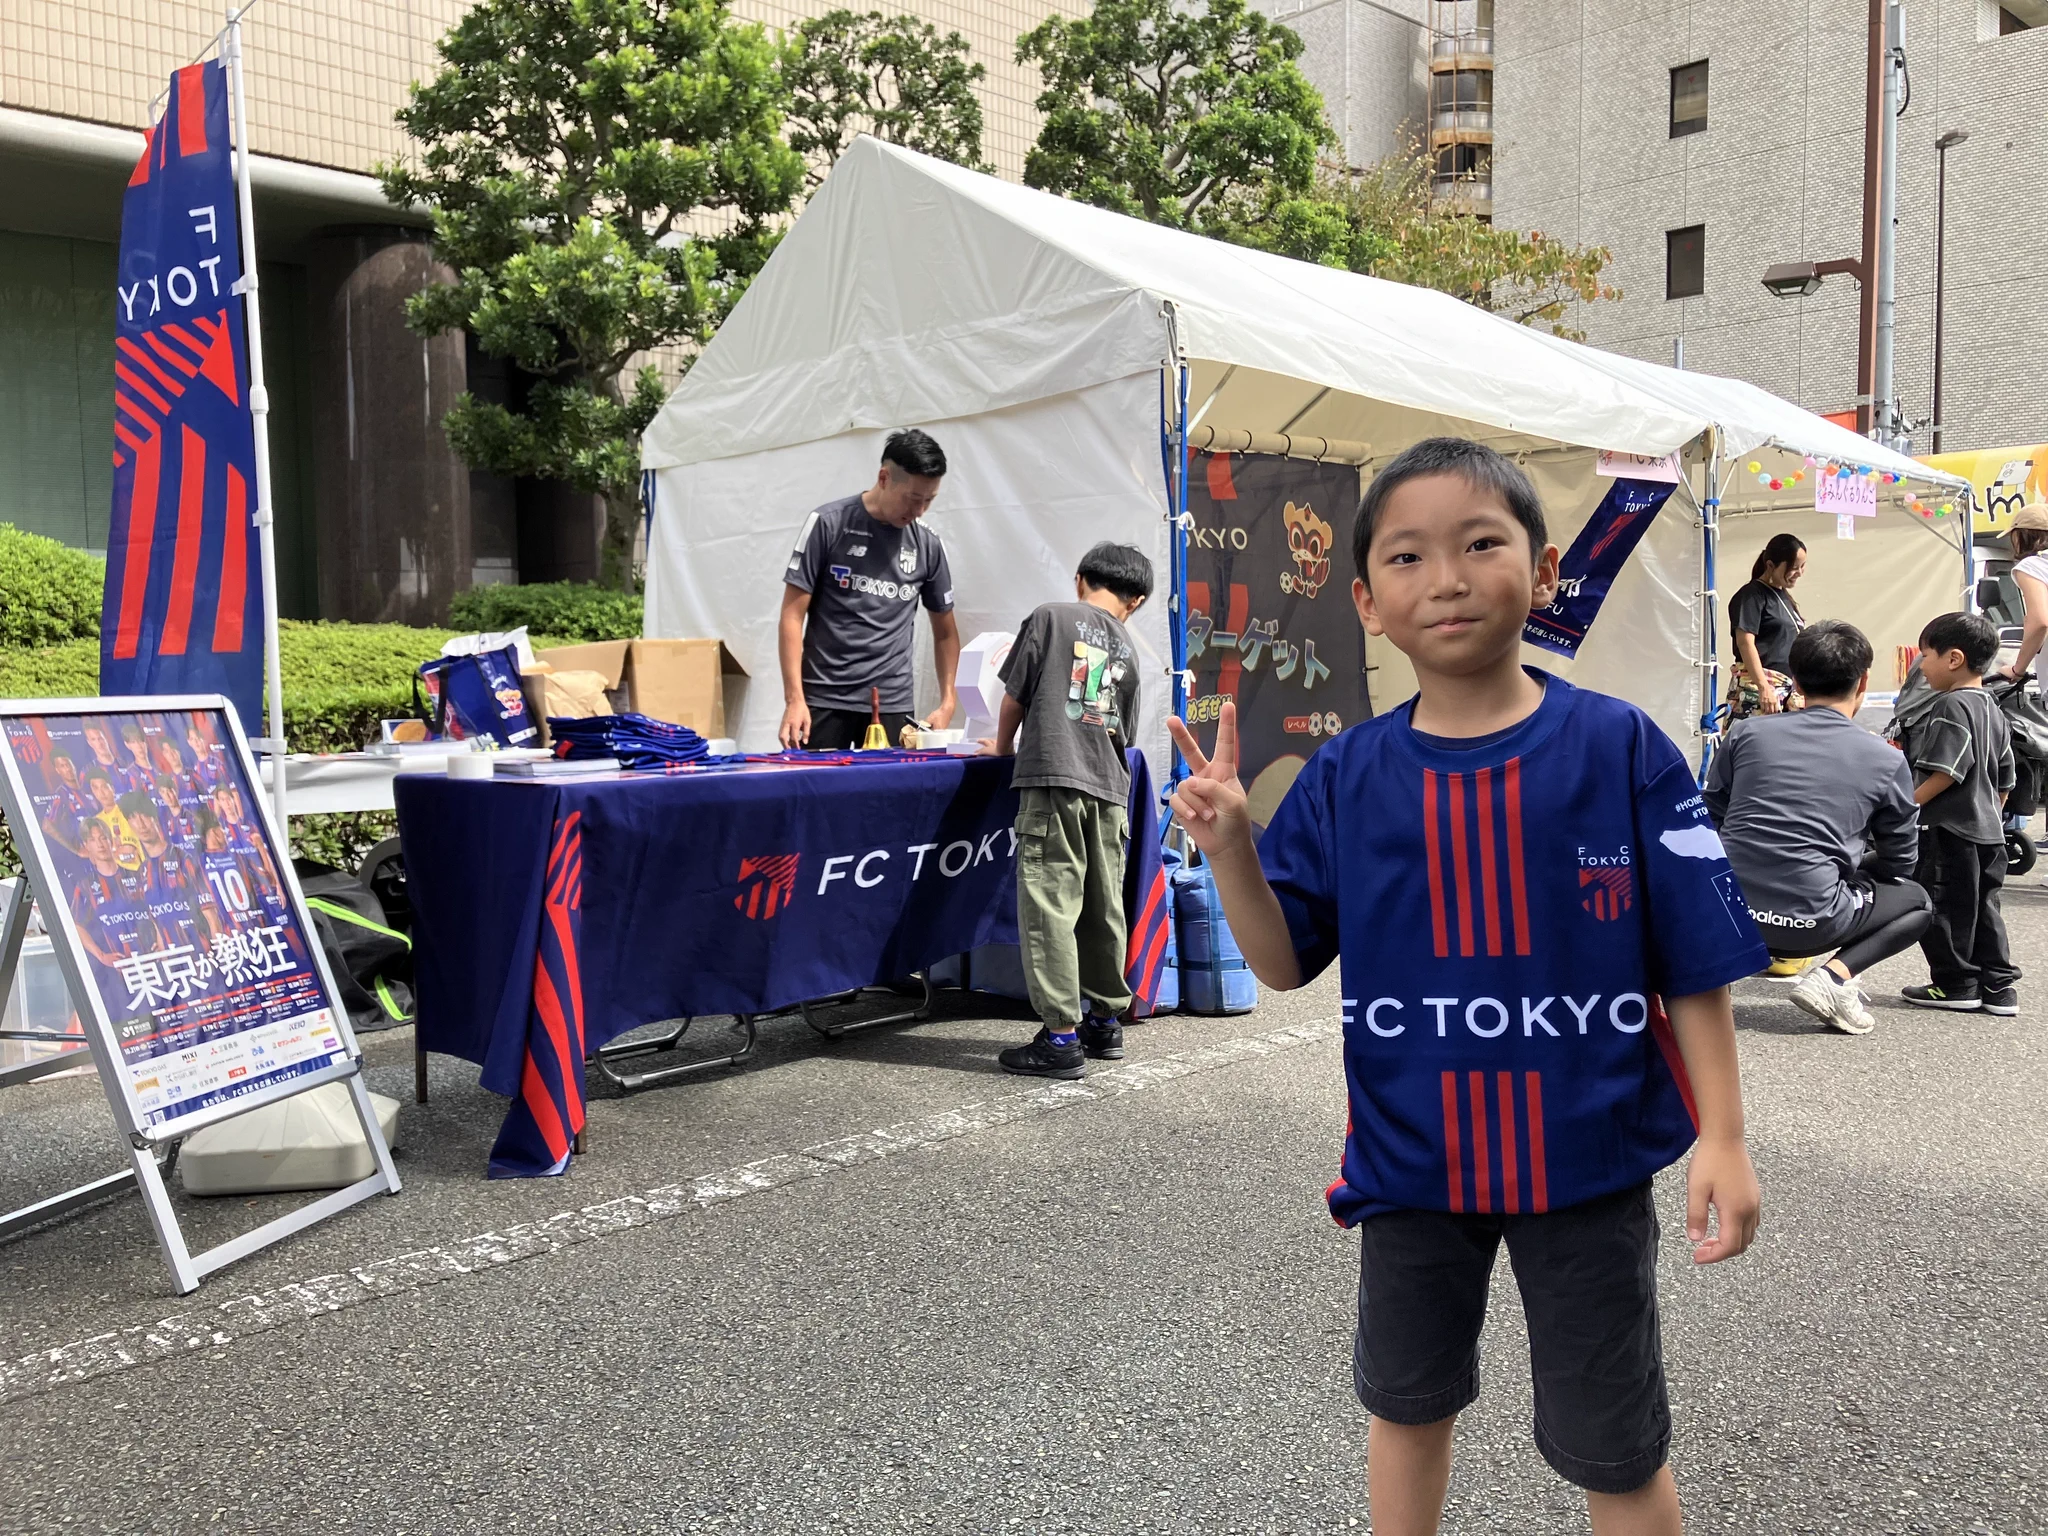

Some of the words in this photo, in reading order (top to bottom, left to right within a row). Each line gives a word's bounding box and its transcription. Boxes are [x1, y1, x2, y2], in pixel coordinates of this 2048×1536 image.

[851, 573, 899, 598] TOKYO
[1186, 608, 1331, 690] ターゲット
[1578, 847, 1586, 856] F
[1620, 846, 1629, 855] C
[1578, 856, 1630, 866] TOKYO
[207, 868, 250, 913] 10
[817, 850, 890, 896] FC
[109, 911, 134, 925] TOKYO
[134, 911, 149, 921] GAS
[113, 924, 297, 1012] 東京が熱狂
[1422, 992, 1648, 1039] TOKYO
[181, 1051, 198, 1061] MIXI
